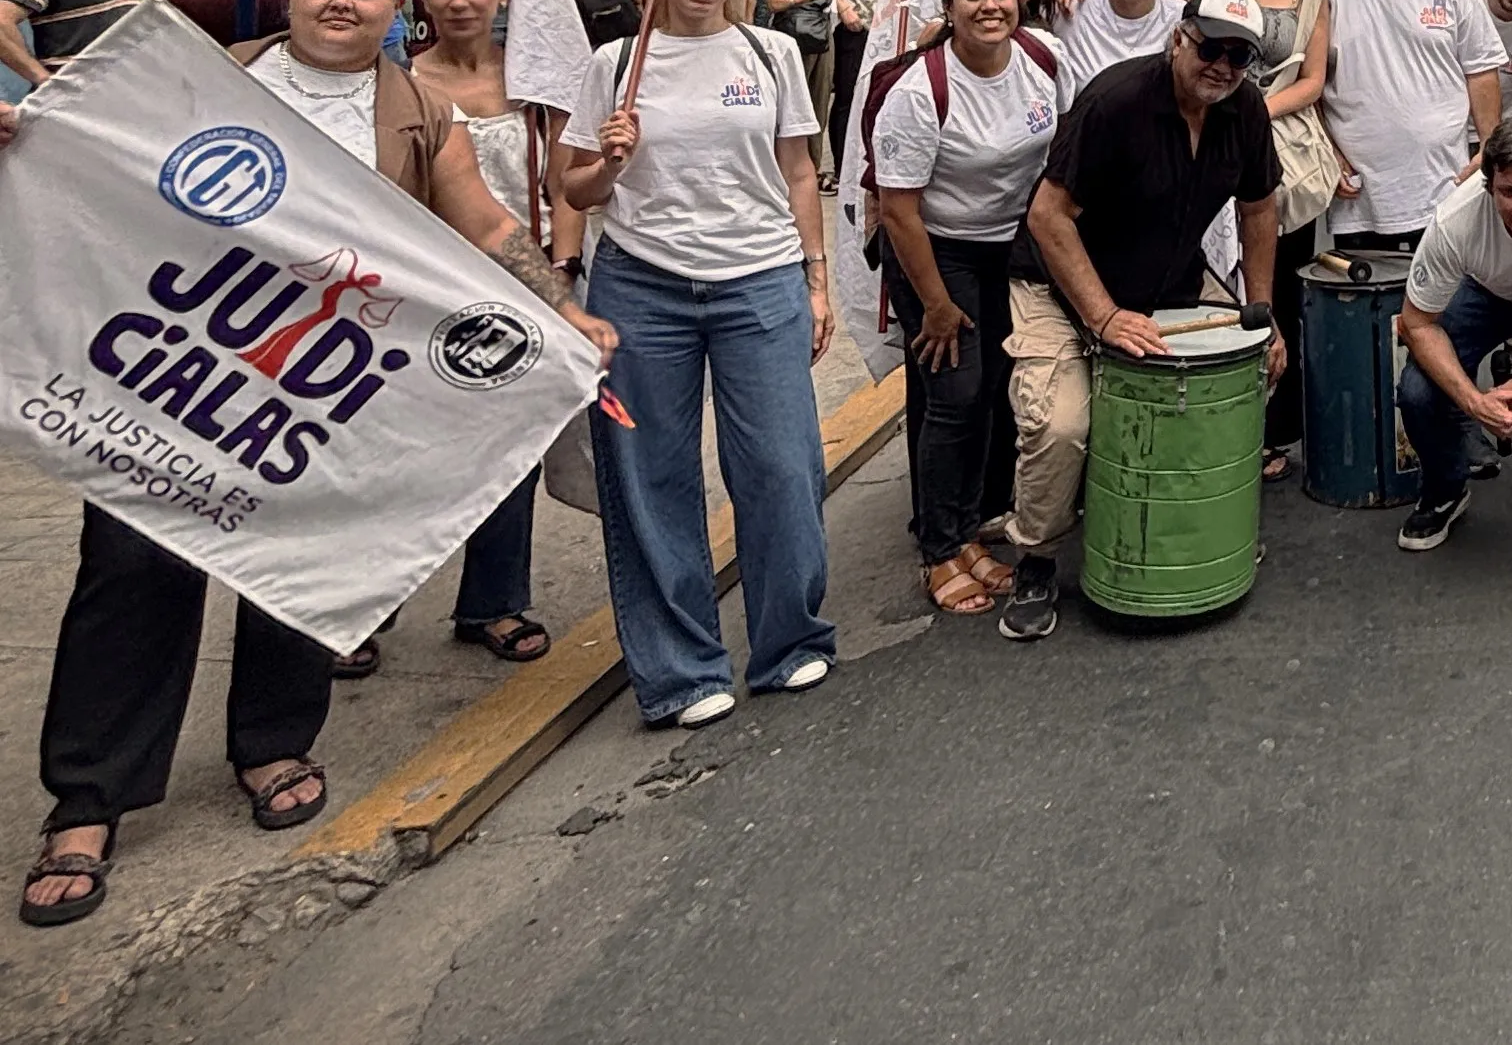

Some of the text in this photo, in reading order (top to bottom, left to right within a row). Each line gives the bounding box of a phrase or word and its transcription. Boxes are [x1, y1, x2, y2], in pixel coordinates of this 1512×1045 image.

[180, 145, 267, 213] CGT
[20, 398, 244, 533] CON NOSOTRAS
[44, 372, 263, 514] LA JUSTICIA ES
